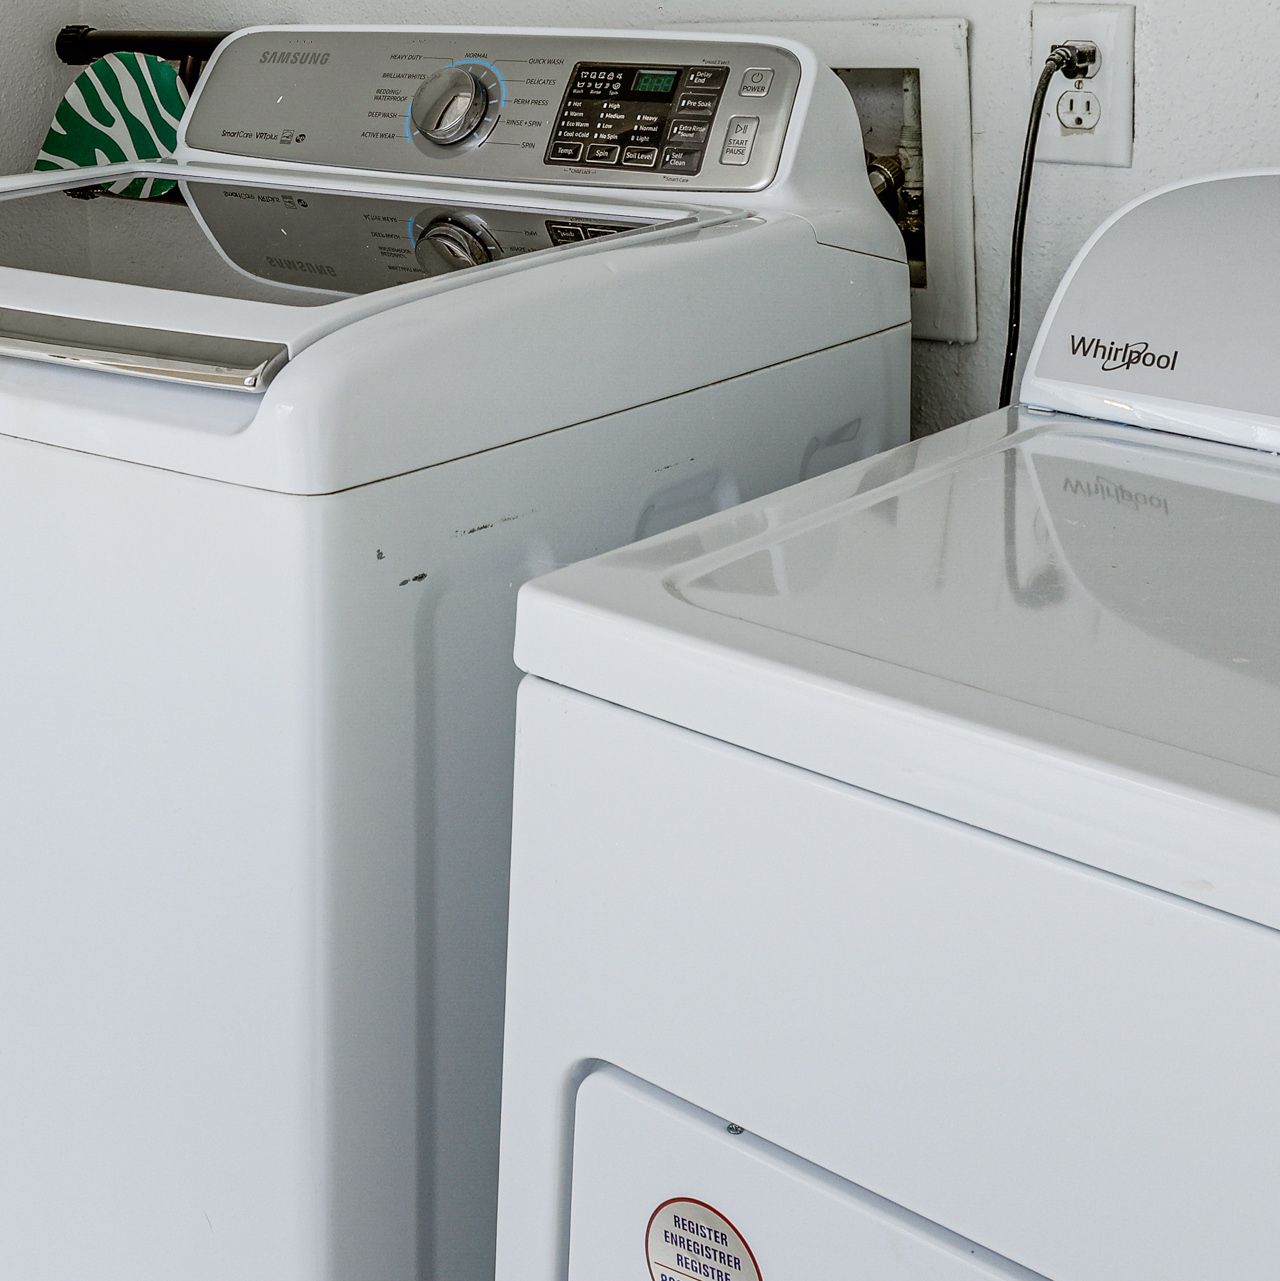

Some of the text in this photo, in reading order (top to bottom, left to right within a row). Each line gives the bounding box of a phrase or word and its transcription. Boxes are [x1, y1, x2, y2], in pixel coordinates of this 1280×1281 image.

[259, 51, 331, 65] SAMSUNG
[525, 78, 556, 86] DELICATES
[361, 131, 379, 139] ACTIVE
[1071, 335, 1178, 371] Whirlpool
[673, 1214, 728, 1247] REGISTER
[664, 1230, 741, 1271] ENREGISTRER
